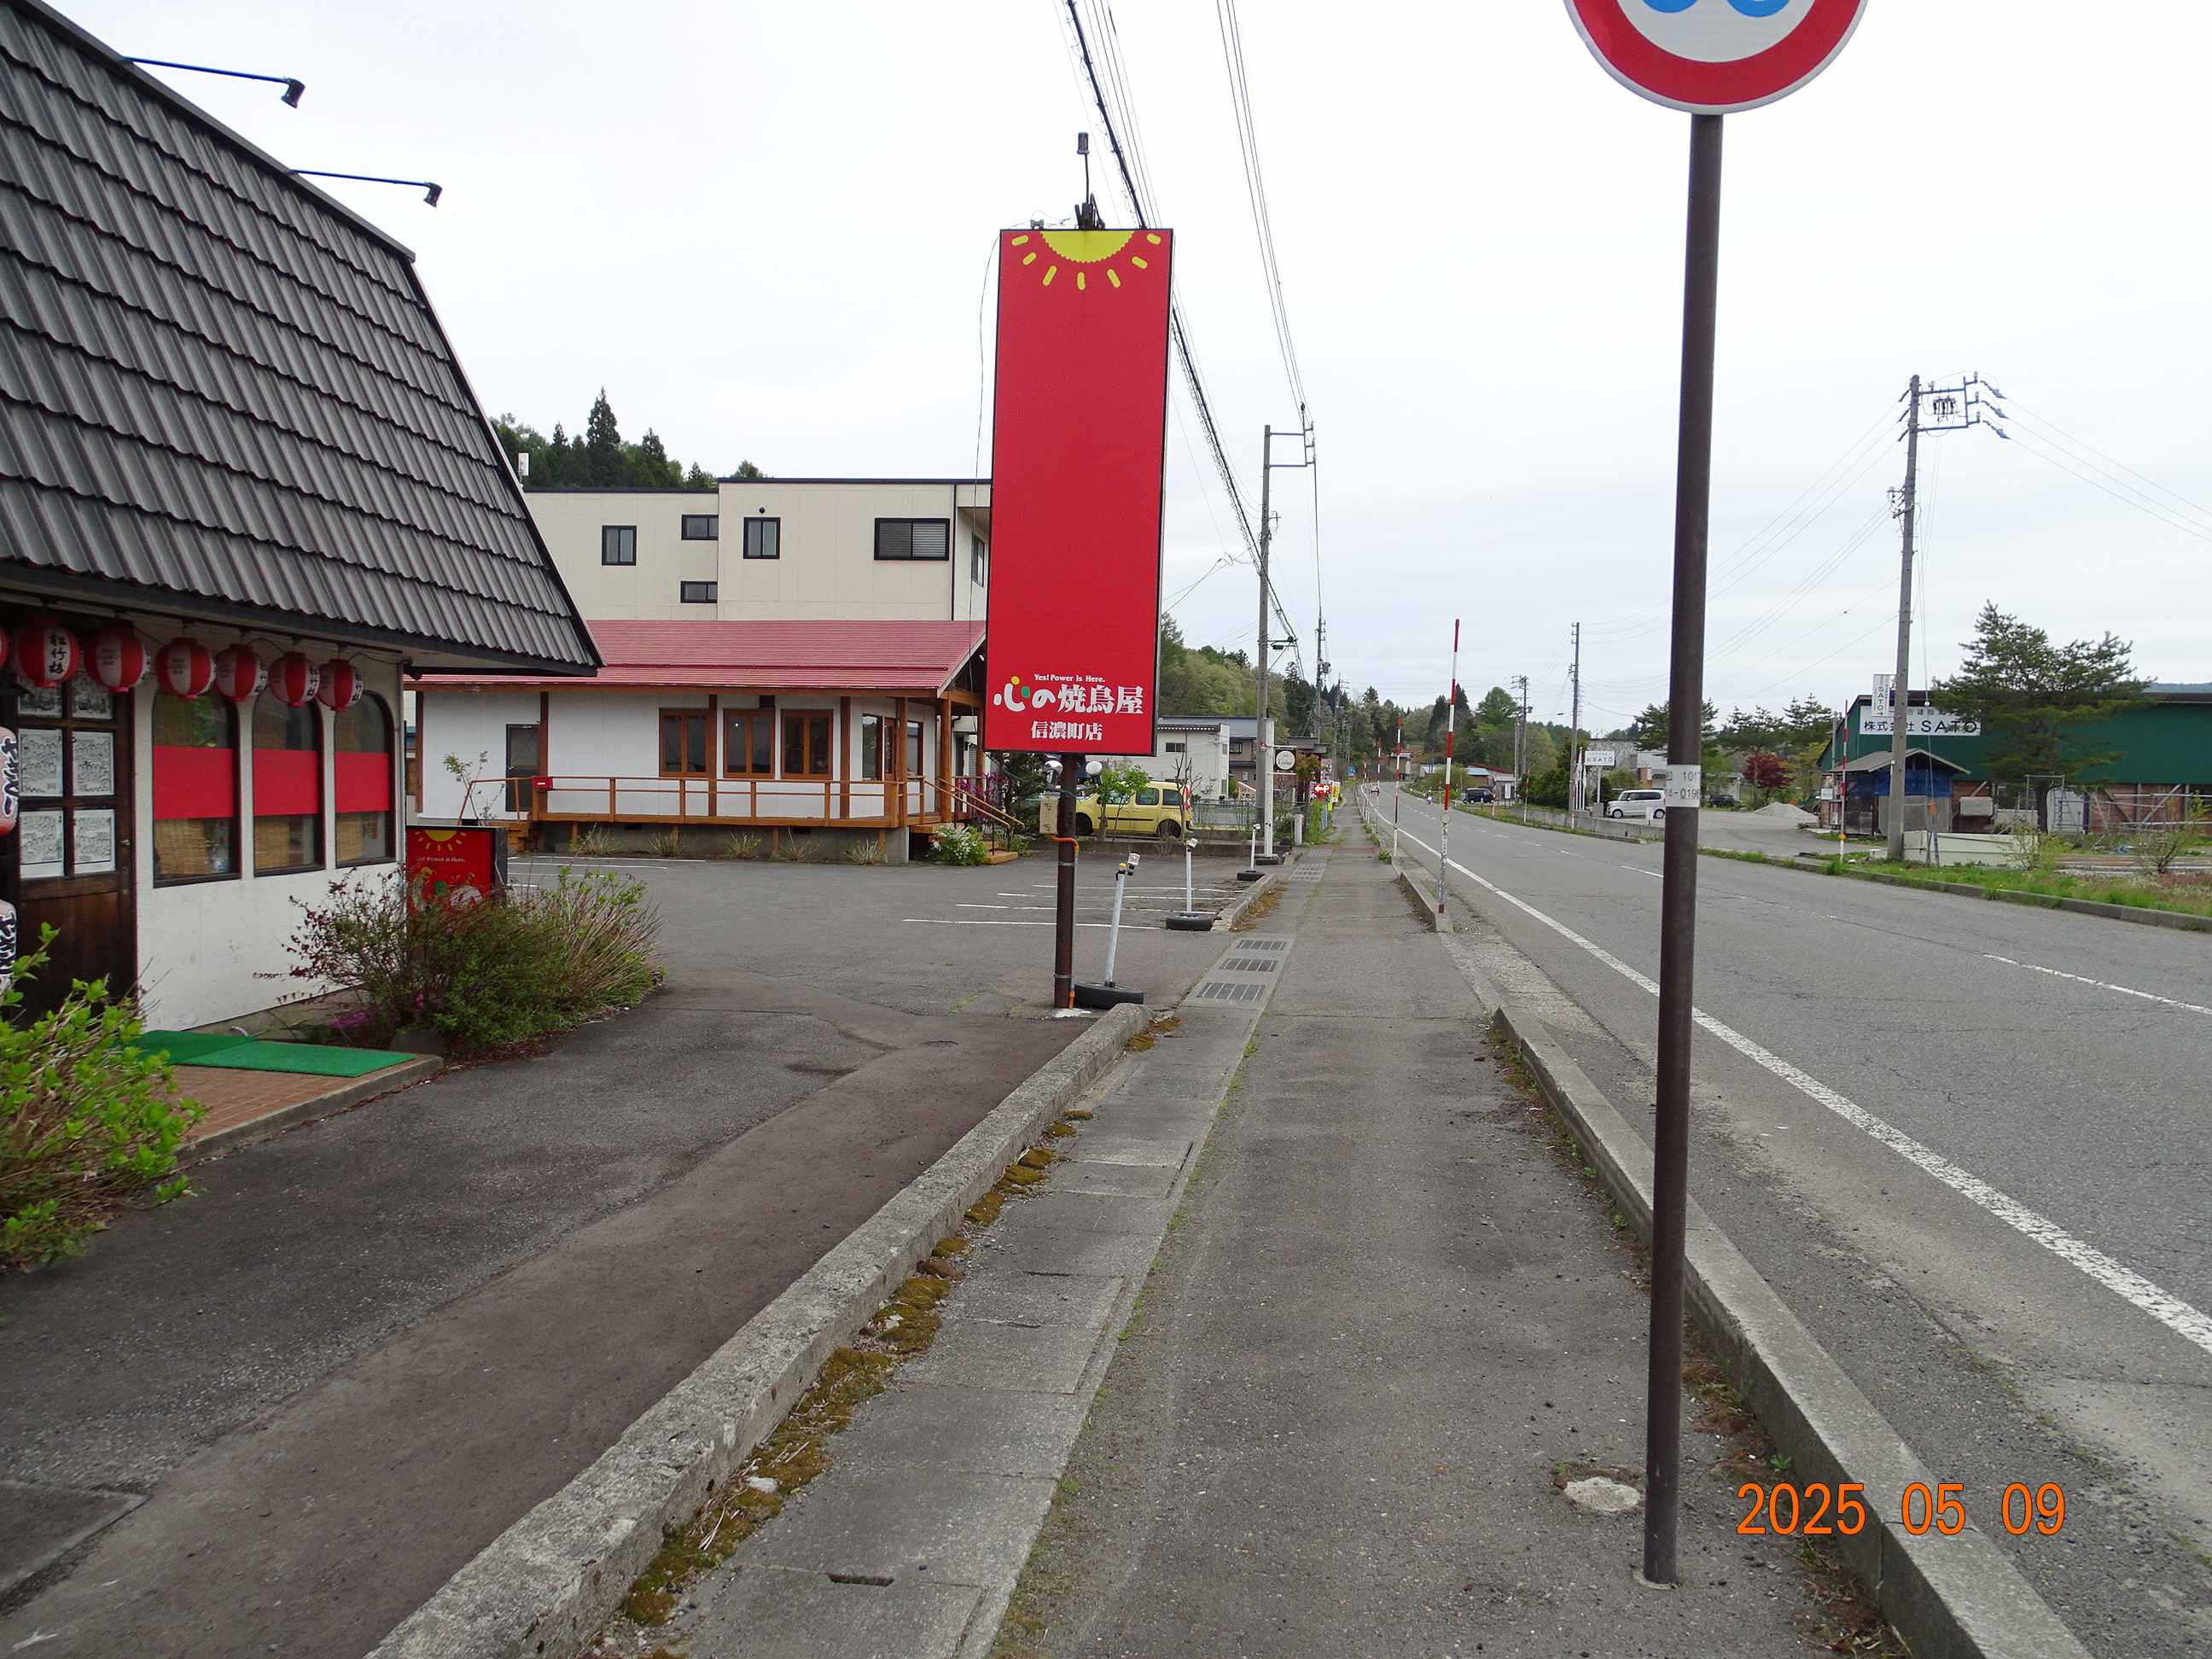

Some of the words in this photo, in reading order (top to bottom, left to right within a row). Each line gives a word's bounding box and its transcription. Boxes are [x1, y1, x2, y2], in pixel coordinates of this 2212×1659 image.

[993, 678, 1144, 714] 心の焼鳥屋
[1031, 720, 1103, 742] 信濃町店
[1920, 719, 1978, 733] SATO
